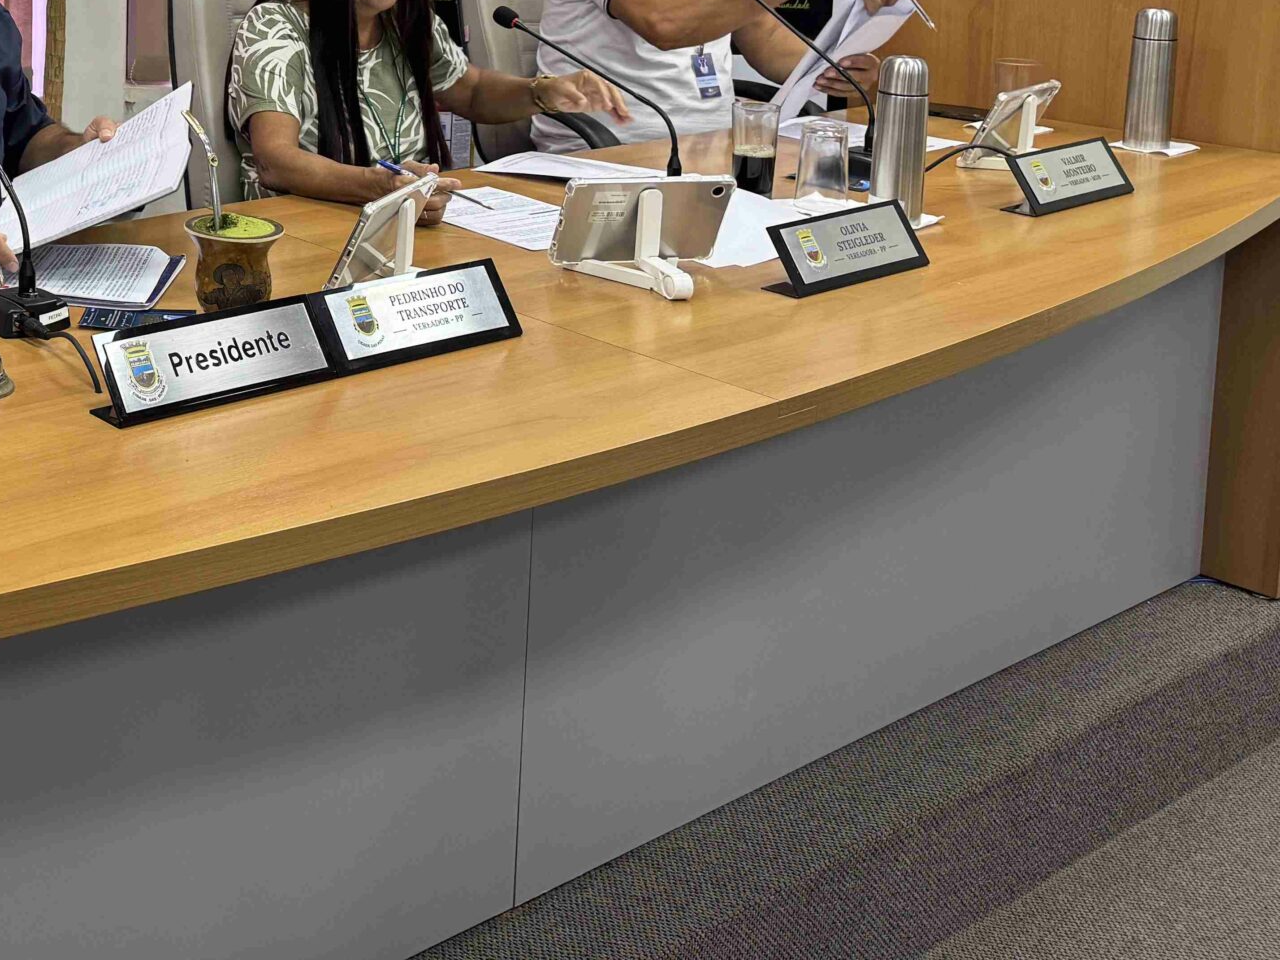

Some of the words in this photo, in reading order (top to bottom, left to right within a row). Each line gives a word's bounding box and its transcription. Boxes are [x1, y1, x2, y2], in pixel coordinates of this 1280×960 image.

[1061, 154, 1086, 165] VALMIR
[1063, 164, 1096, 178] MONTEIRO
[840, 222, 869, 236] OLIVIA
[837, 232, 886, 251] STEIGLEDER
[846, 249, 877, 260] VEREADORA
[389, 286, 446, 306] PEDRINHO
[448, 282, 465, 295] DO
[397, 298, 469, 321] TRANSPORTE
[413, 316, 449, 331] VEREADOR
[168, 330, 291, 377] Presidente
